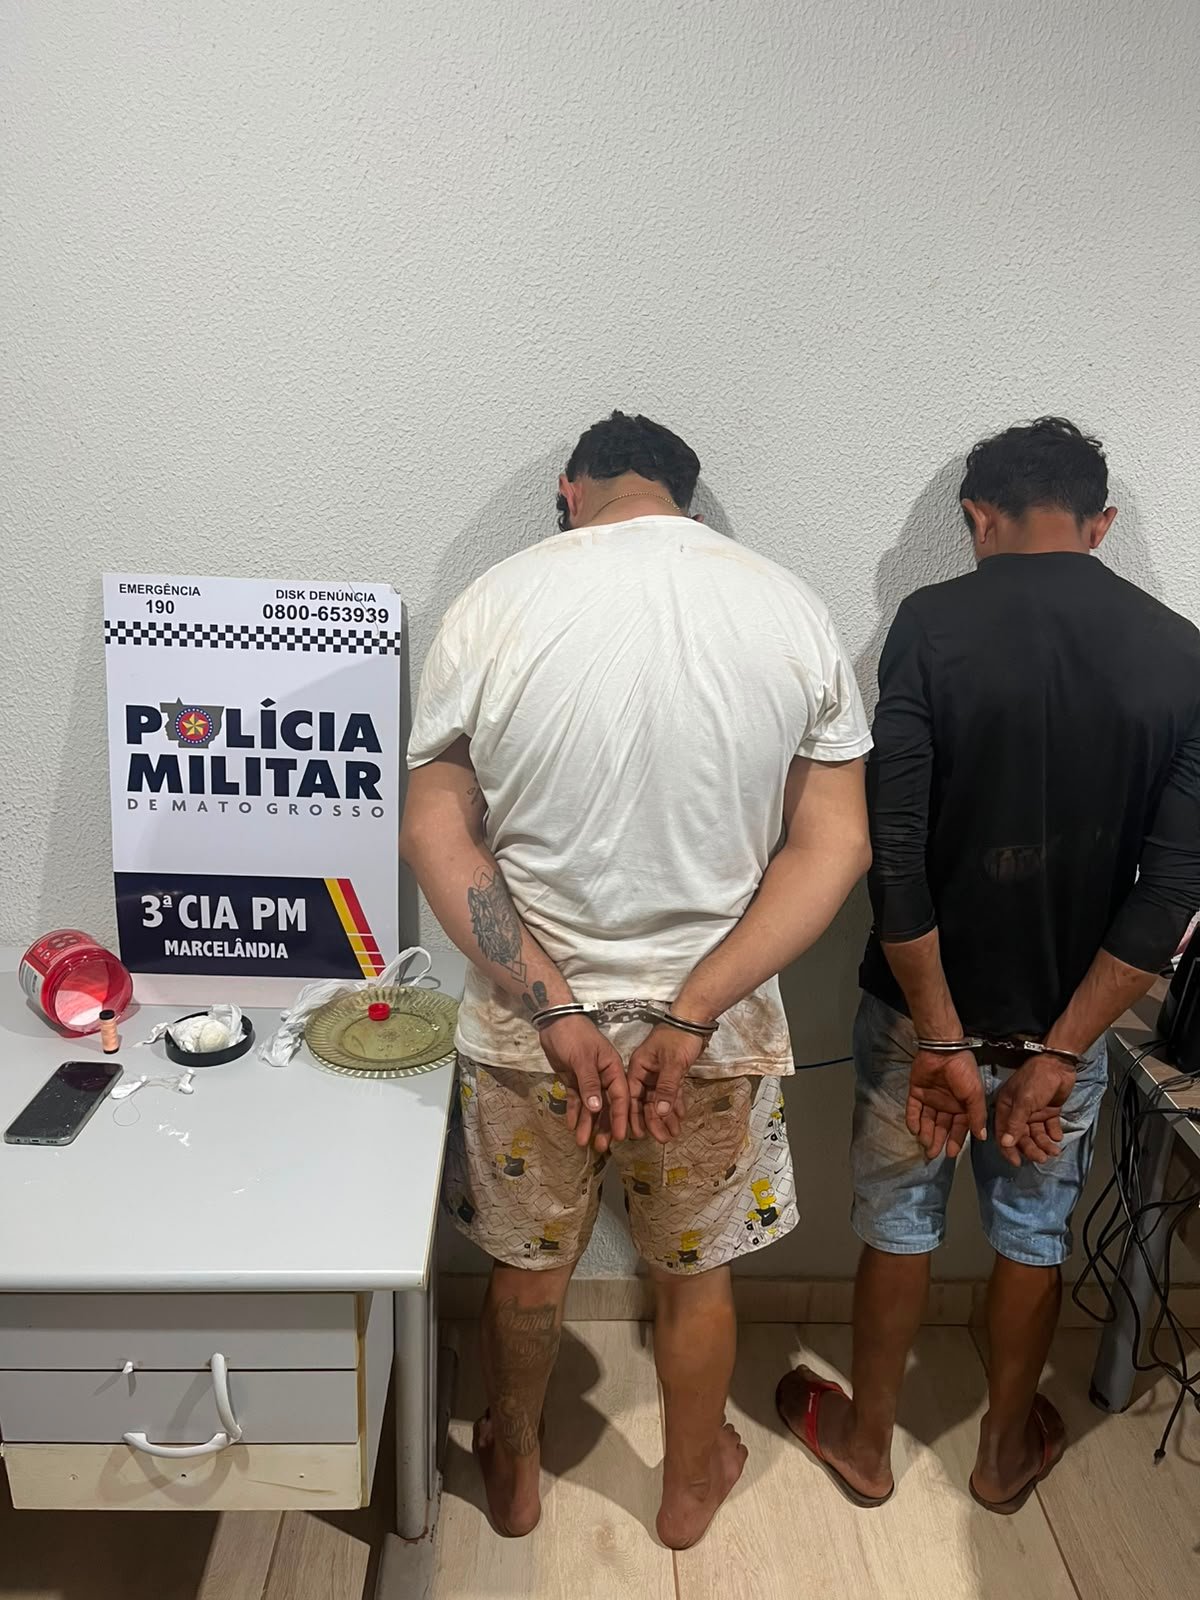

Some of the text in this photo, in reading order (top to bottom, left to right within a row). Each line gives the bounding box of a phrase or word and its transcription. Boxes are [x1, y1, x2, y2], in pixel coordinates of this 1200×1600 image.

[119, 582, 201, 597] EMERGÊNCIA
[275, 588, 377, 603] DISK DENÚNCIA
[145, 599, 175, 615] 190
[262, 603, 390, 625] 0800-653939
[126, 752, 383, 801] MILITAR
[127, 798, 385, 819] DE MATO GROSSO
[178, 894, 239, 931] CIA
[251, 896, 307, 932] PM
[164, 937, 289, 960] MARCELÂNDIA
